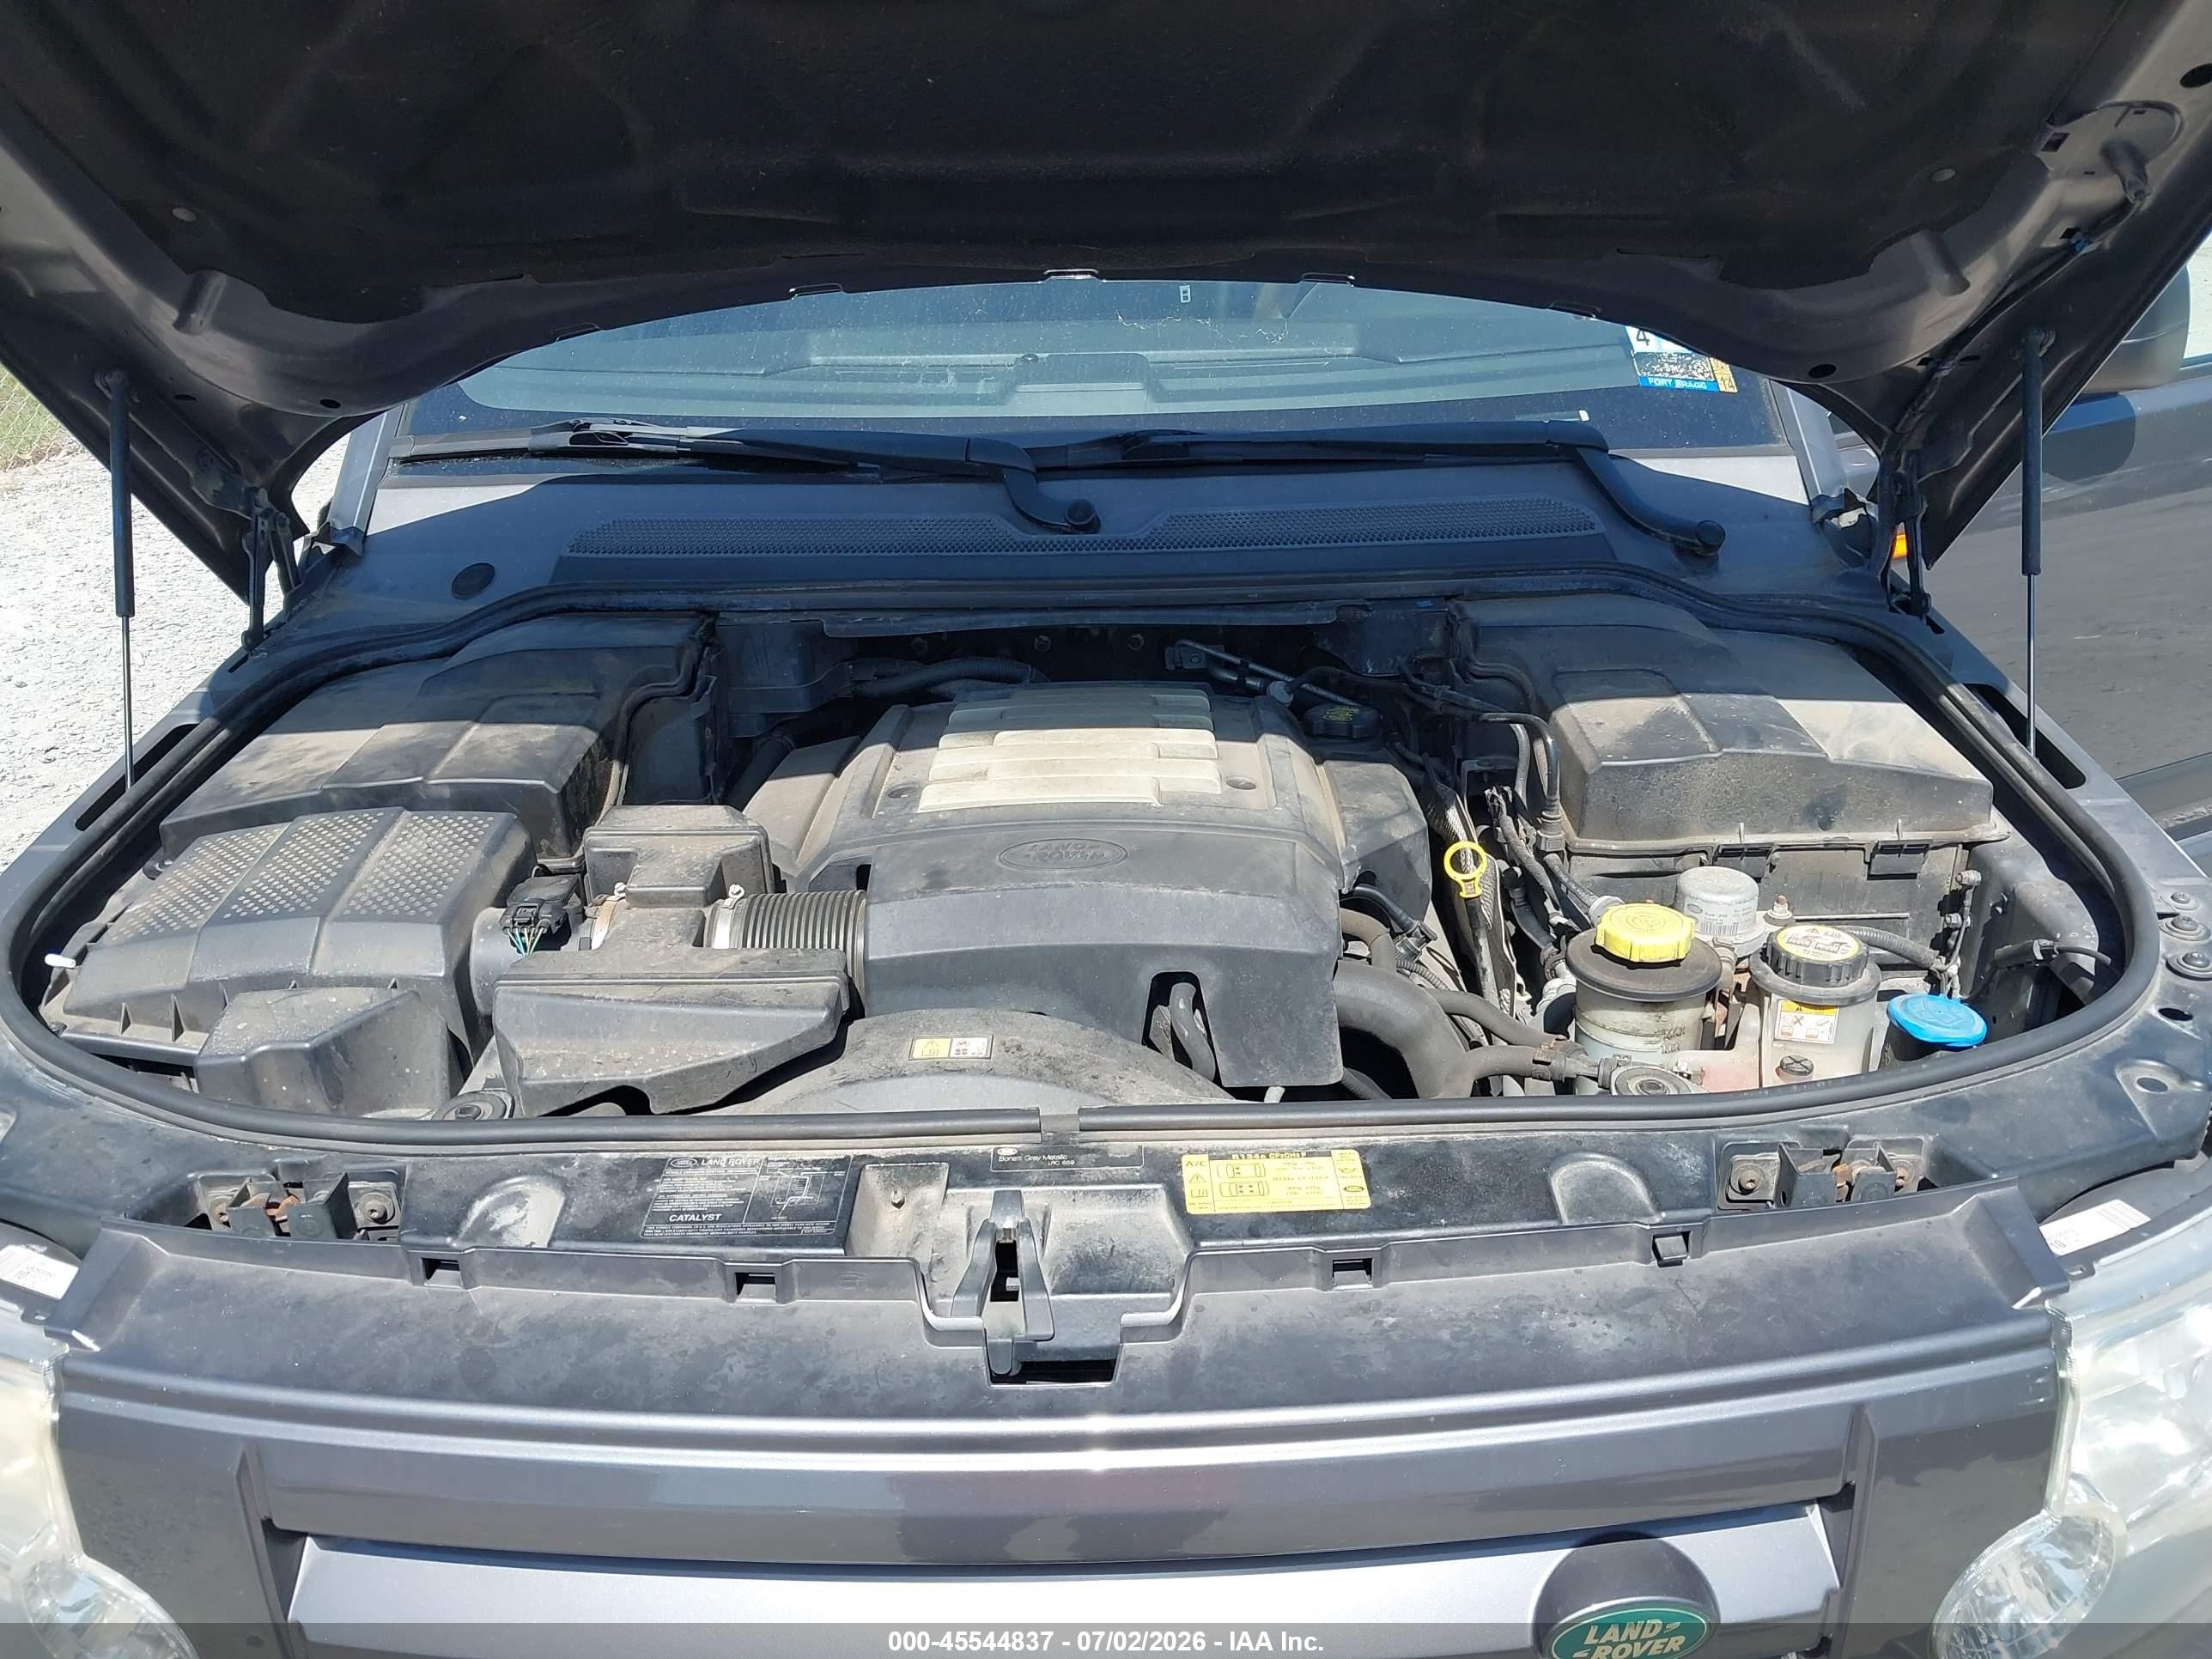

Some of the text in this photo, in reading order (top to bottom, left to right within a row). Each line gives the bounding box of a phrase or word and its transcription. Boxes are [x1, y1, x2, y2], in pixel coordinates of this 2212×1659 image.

[1648, 378, 1708, 390] FORT BRAGG
[728, 1158, 760, 1166] ROVER
[669, 1213, 722, 1223] CATALYST
[1583, 1619, 1663, 1645] LAND
[1591, 1635, 1686, 1659] ROVER
